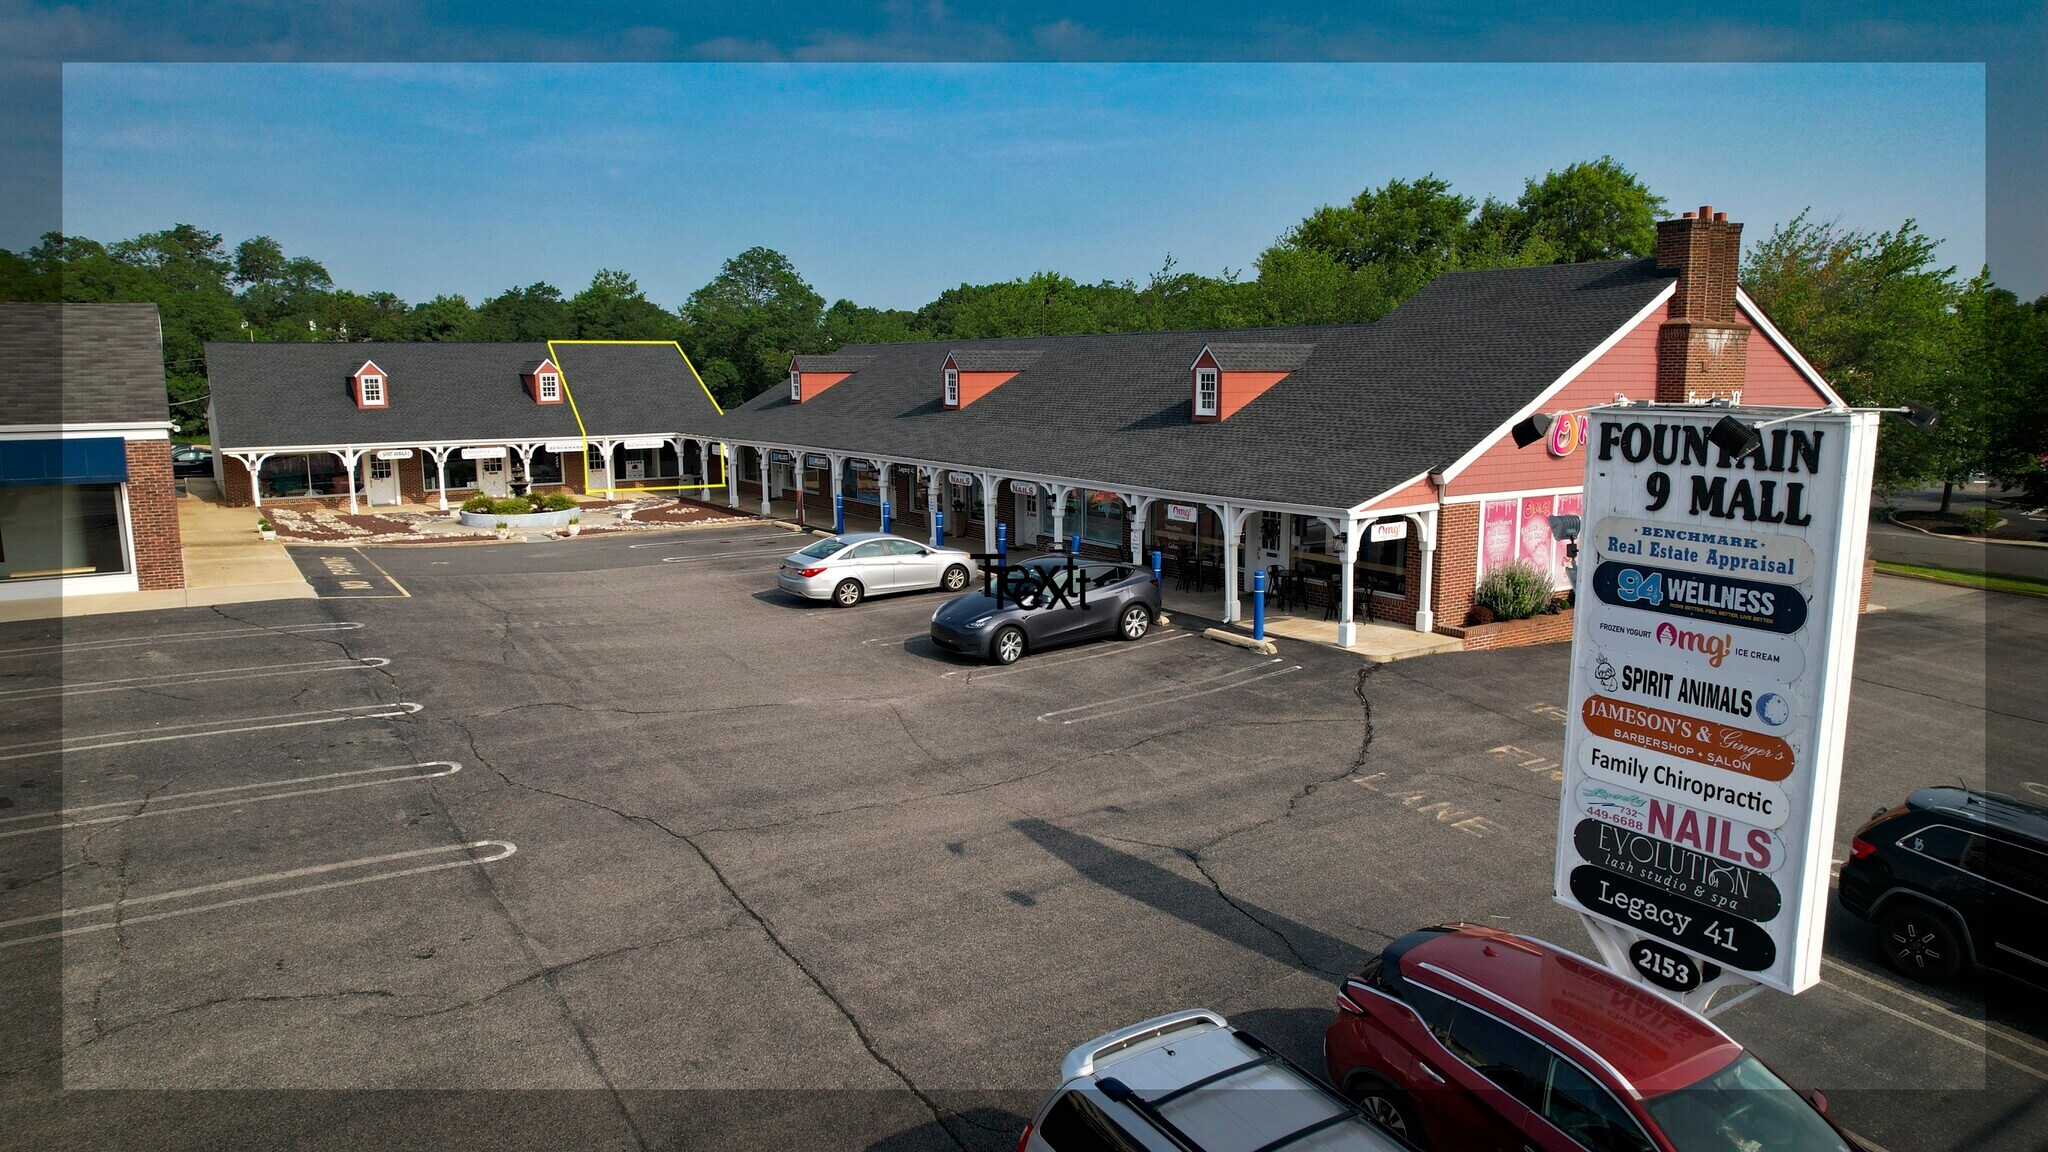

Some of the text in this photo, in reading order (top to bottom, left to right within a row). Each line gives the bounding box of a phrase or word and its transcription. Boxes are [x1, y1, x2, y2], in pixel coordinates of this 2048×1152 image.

[951, 474, 970, 485] NAILS
[1012, 484, 1034, 495] NAILS
[1645, 471, 1811, 526] 9 MALL
[1608, 536, 1795, 576] Real Estate Appraisal
[1641, 527, 1758, 550] BENCHMARK
[1617, 568, 1775, 617] 94 WELLNESS
[1599, 622, 1652, 639] FROZEN YOGURT
[1735, 648, 1781, 663] ICE CREAM
[1622, 665, 1752, 717] SPIRIT ANIMALS
[1590, 700, 1692, 738] JAMESON'S
[1695, 725, 1712, 744] &
[1718, 727, 1785, 761] Ginger's
[1613, 728, 1694, 757] BARBERSHOP
[1707, 752, 1751, 772] SALON
[1591, 748, 1649, 784] Family
[1653, 765, 1773, 815] Chiropractic
[1586, 806, 1643, 832] 449-6688
[1647, 799, 1772, 870] NAILS
[1604, 853, 1739, 910] lash studio & spa
[1598, 880, 1739, 953] Legacy 41
[1638, 948, 1689, 984] 2153
